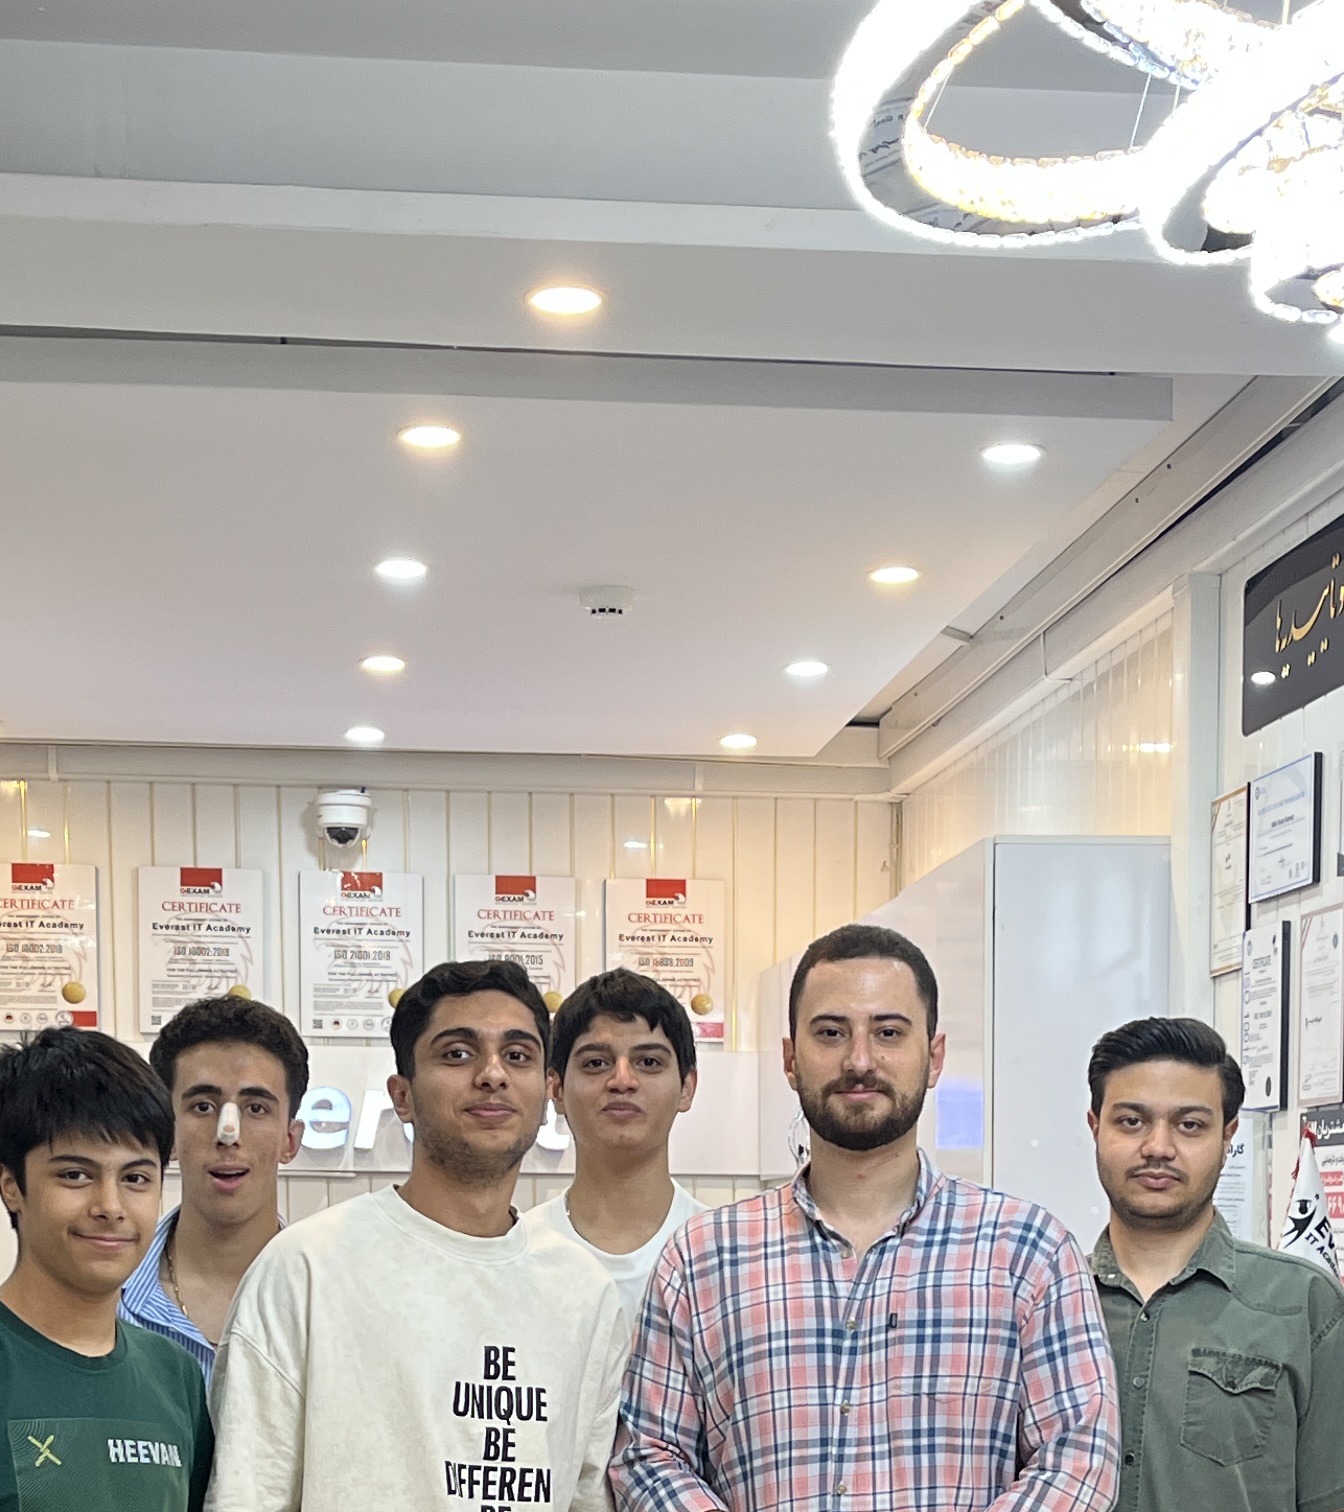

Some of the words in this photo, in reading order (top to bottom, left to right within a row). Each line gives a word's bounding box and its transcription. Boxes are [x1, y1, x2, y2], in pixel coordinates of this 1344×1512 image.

[161, 901, 242, 914] CERTIFICATE
[322, 905, 402, 918] CERTIFICATE
[477, 909, 555, 921] CERTIFICATE
[627, 913, 705, 925] CERTIFICATE
[38, 921, 85, 931] Academy
[152, 922, 190, 932] Everest
[205, 924, 252, 934] Academy
[313, 927, 351, 936] Everest
[366, 928, 411, 938] Academy
[467, 930, 505, 939] Everest
[519, 931, 564, 941] Academy
[618, 933, 655, 943] Everest
[670, 935, 714, 945] Academy
[483, 1345, 516, 1381] BE
[453, 1381, 548, 1426] UNIQUE
[483, 1427, 516, 1462] BE
[107, 1439, 183, 1467] HEEVAN
